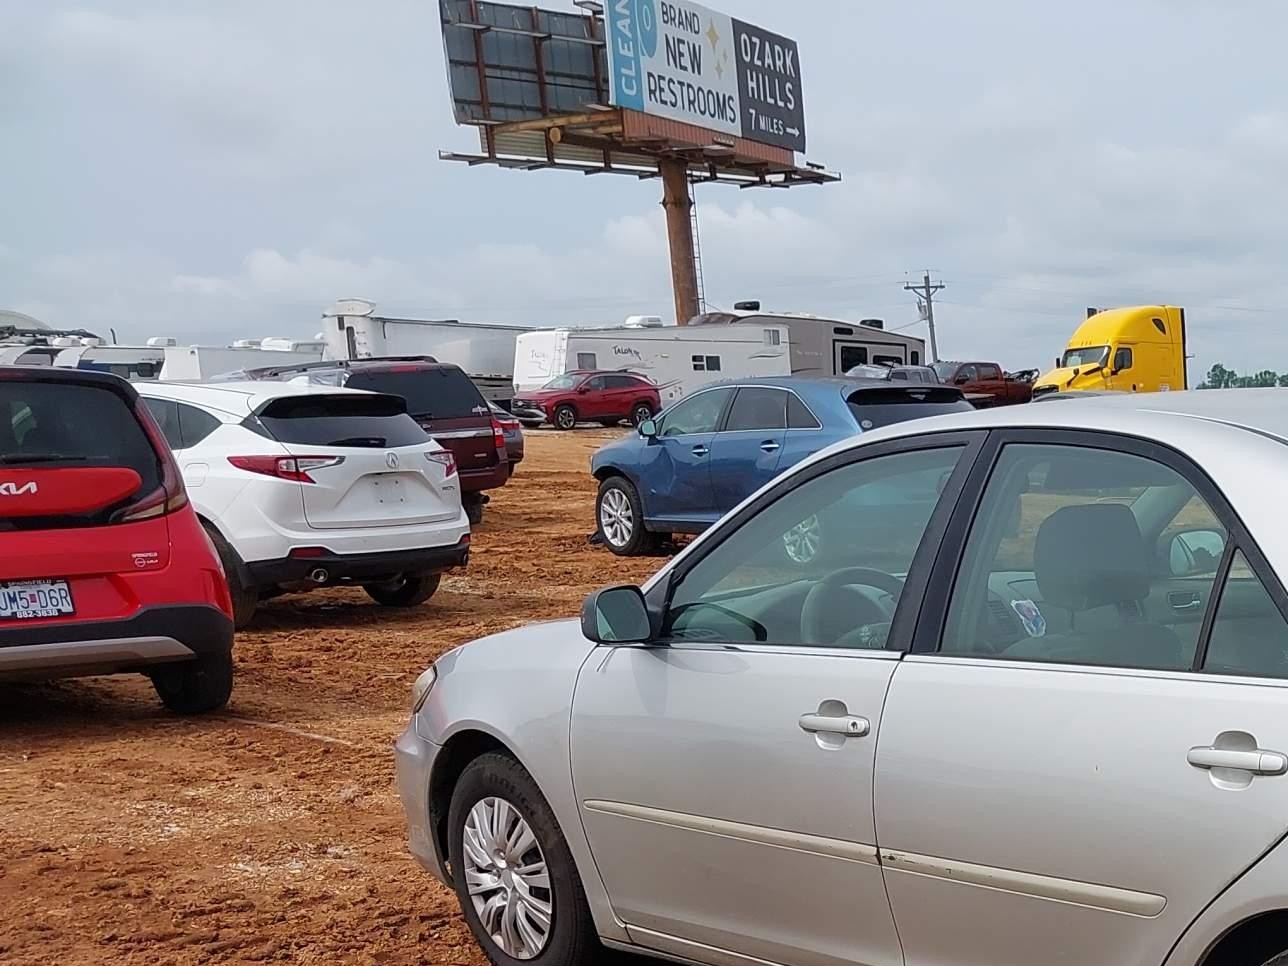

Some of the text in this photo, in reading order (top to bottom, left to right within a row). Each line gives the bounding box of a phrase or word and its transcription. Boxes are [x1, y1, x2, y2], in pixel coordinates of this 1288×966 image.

[661, 1, 700, 35] BRAND
[615, 0, 637, 96] CLEAN
[665, 33, 702, 76] NEW
[740, 33, 795, 78] OZARK
[647, 71, 736, 124] RESTROOMS
[747, 69, 795, 110] HILLS
[749, 108, 784, 135] 7 MILES
